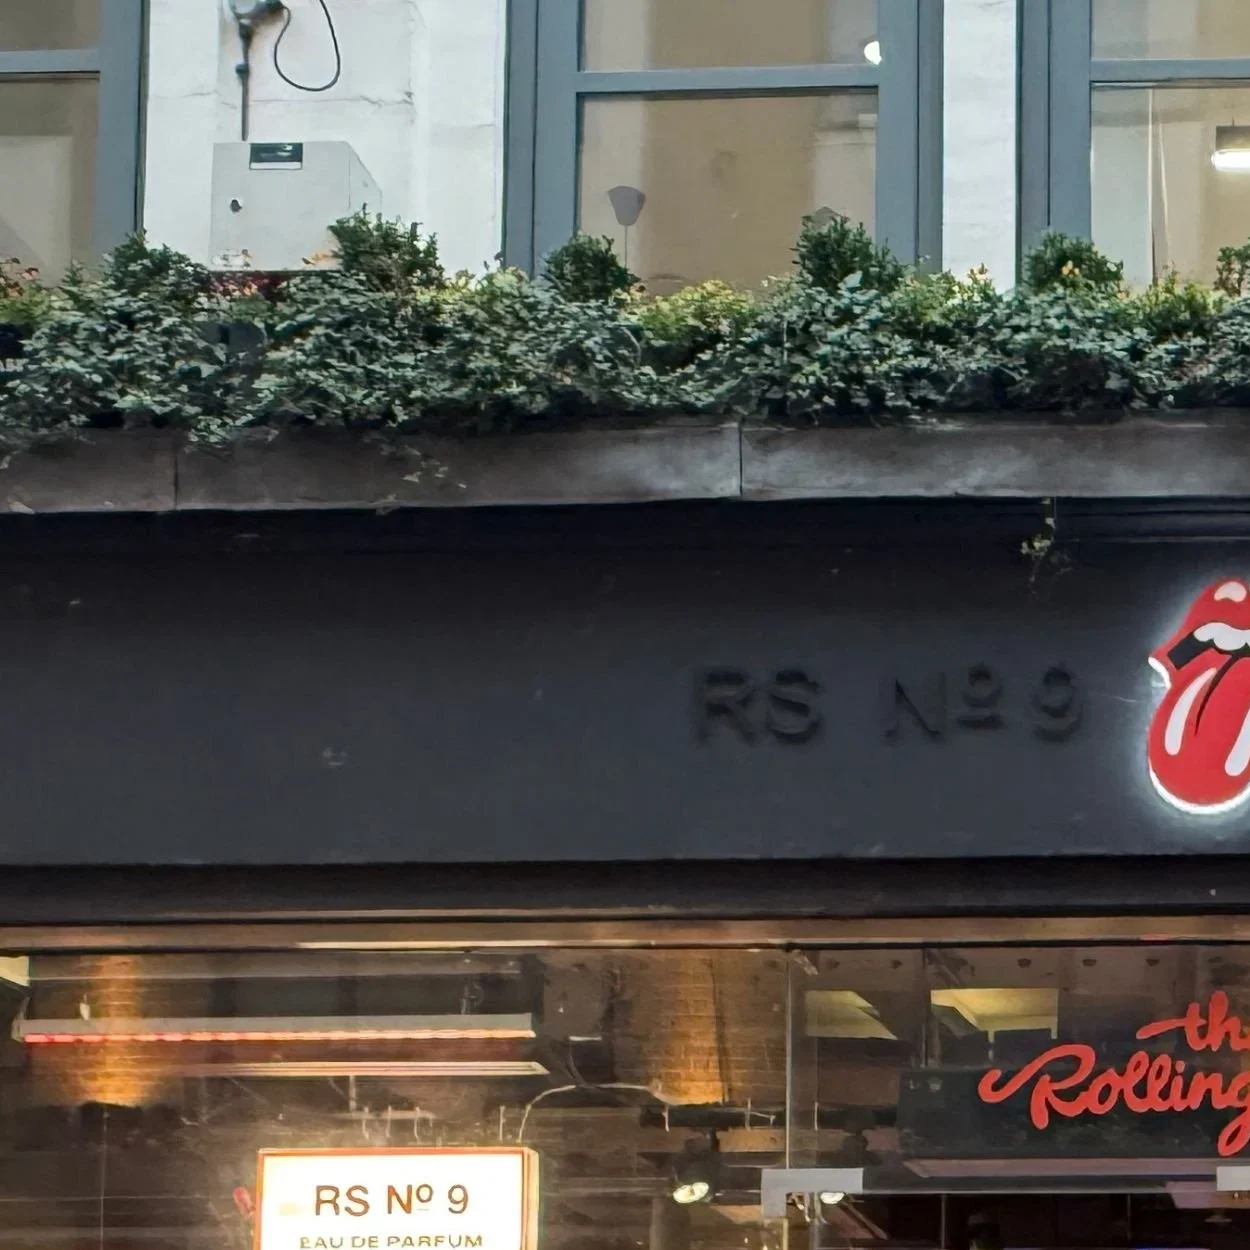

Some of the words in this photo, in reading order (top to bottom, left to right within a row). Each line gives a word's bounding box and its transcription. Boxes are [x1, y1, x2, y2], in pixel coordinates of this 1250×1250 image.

[697, 664, 824, 744] RS
[1031, 664, 1083, 744] 9
[314, 1184, 370, 1217] RS
[446, 1184, 469, 1215] 9
[299, 1236, 344, 1250] EAU
[351, 1235, 379, 1249] DE
[386, 1234, 484, 1249] PARFUM
